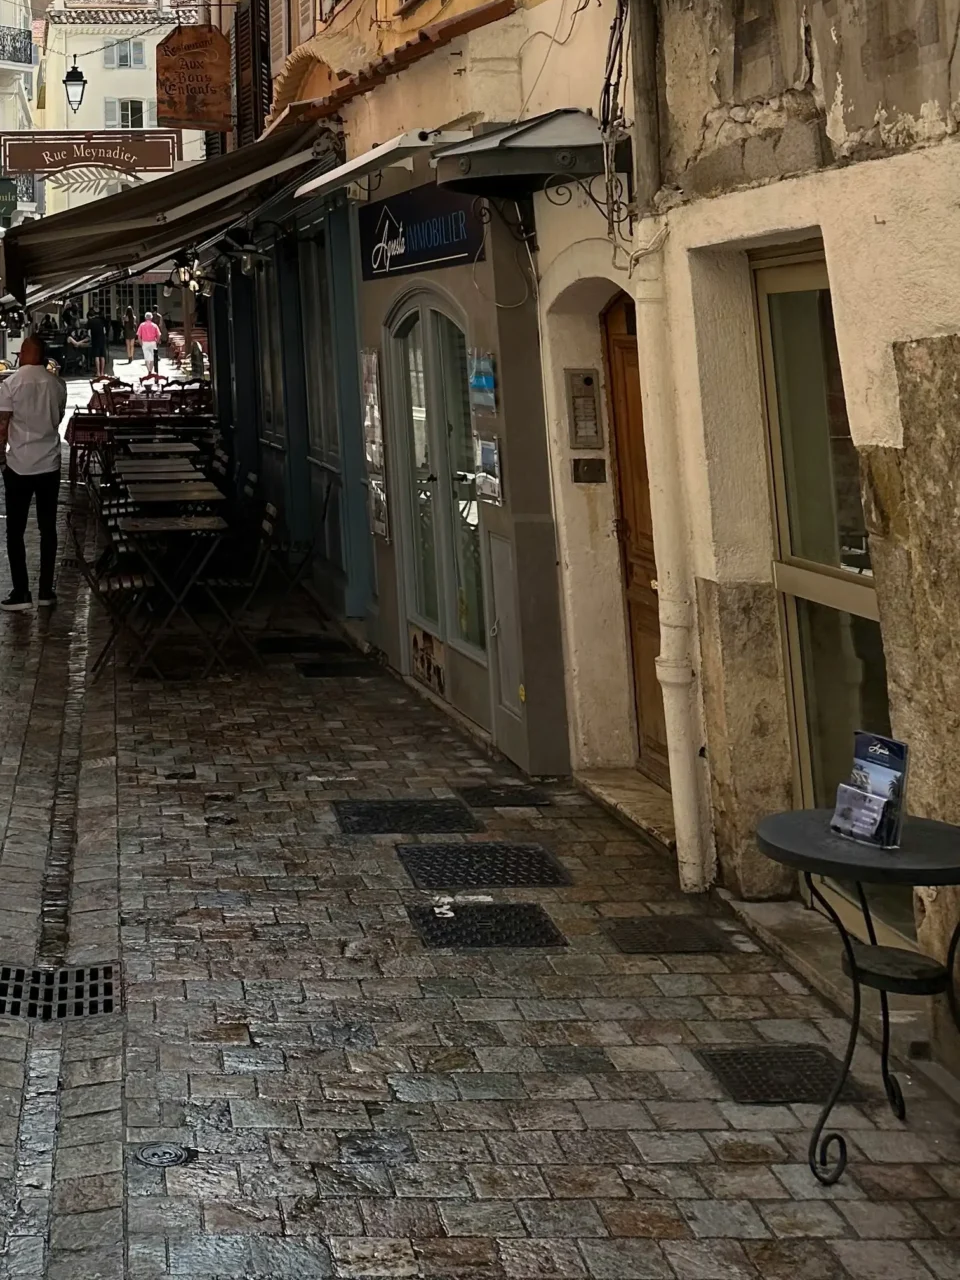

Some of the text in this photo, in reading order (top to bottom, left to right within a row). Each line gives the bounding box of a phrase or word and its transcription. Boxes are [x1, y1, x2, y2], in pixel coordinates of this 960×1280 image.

[175, 71, 212, 84] Bons
[164, 83, 217, 96] Enfants
[42, 144, 138, 165] Rue Meynadier
[406, 210, 468, 253] IMMOBILIER
